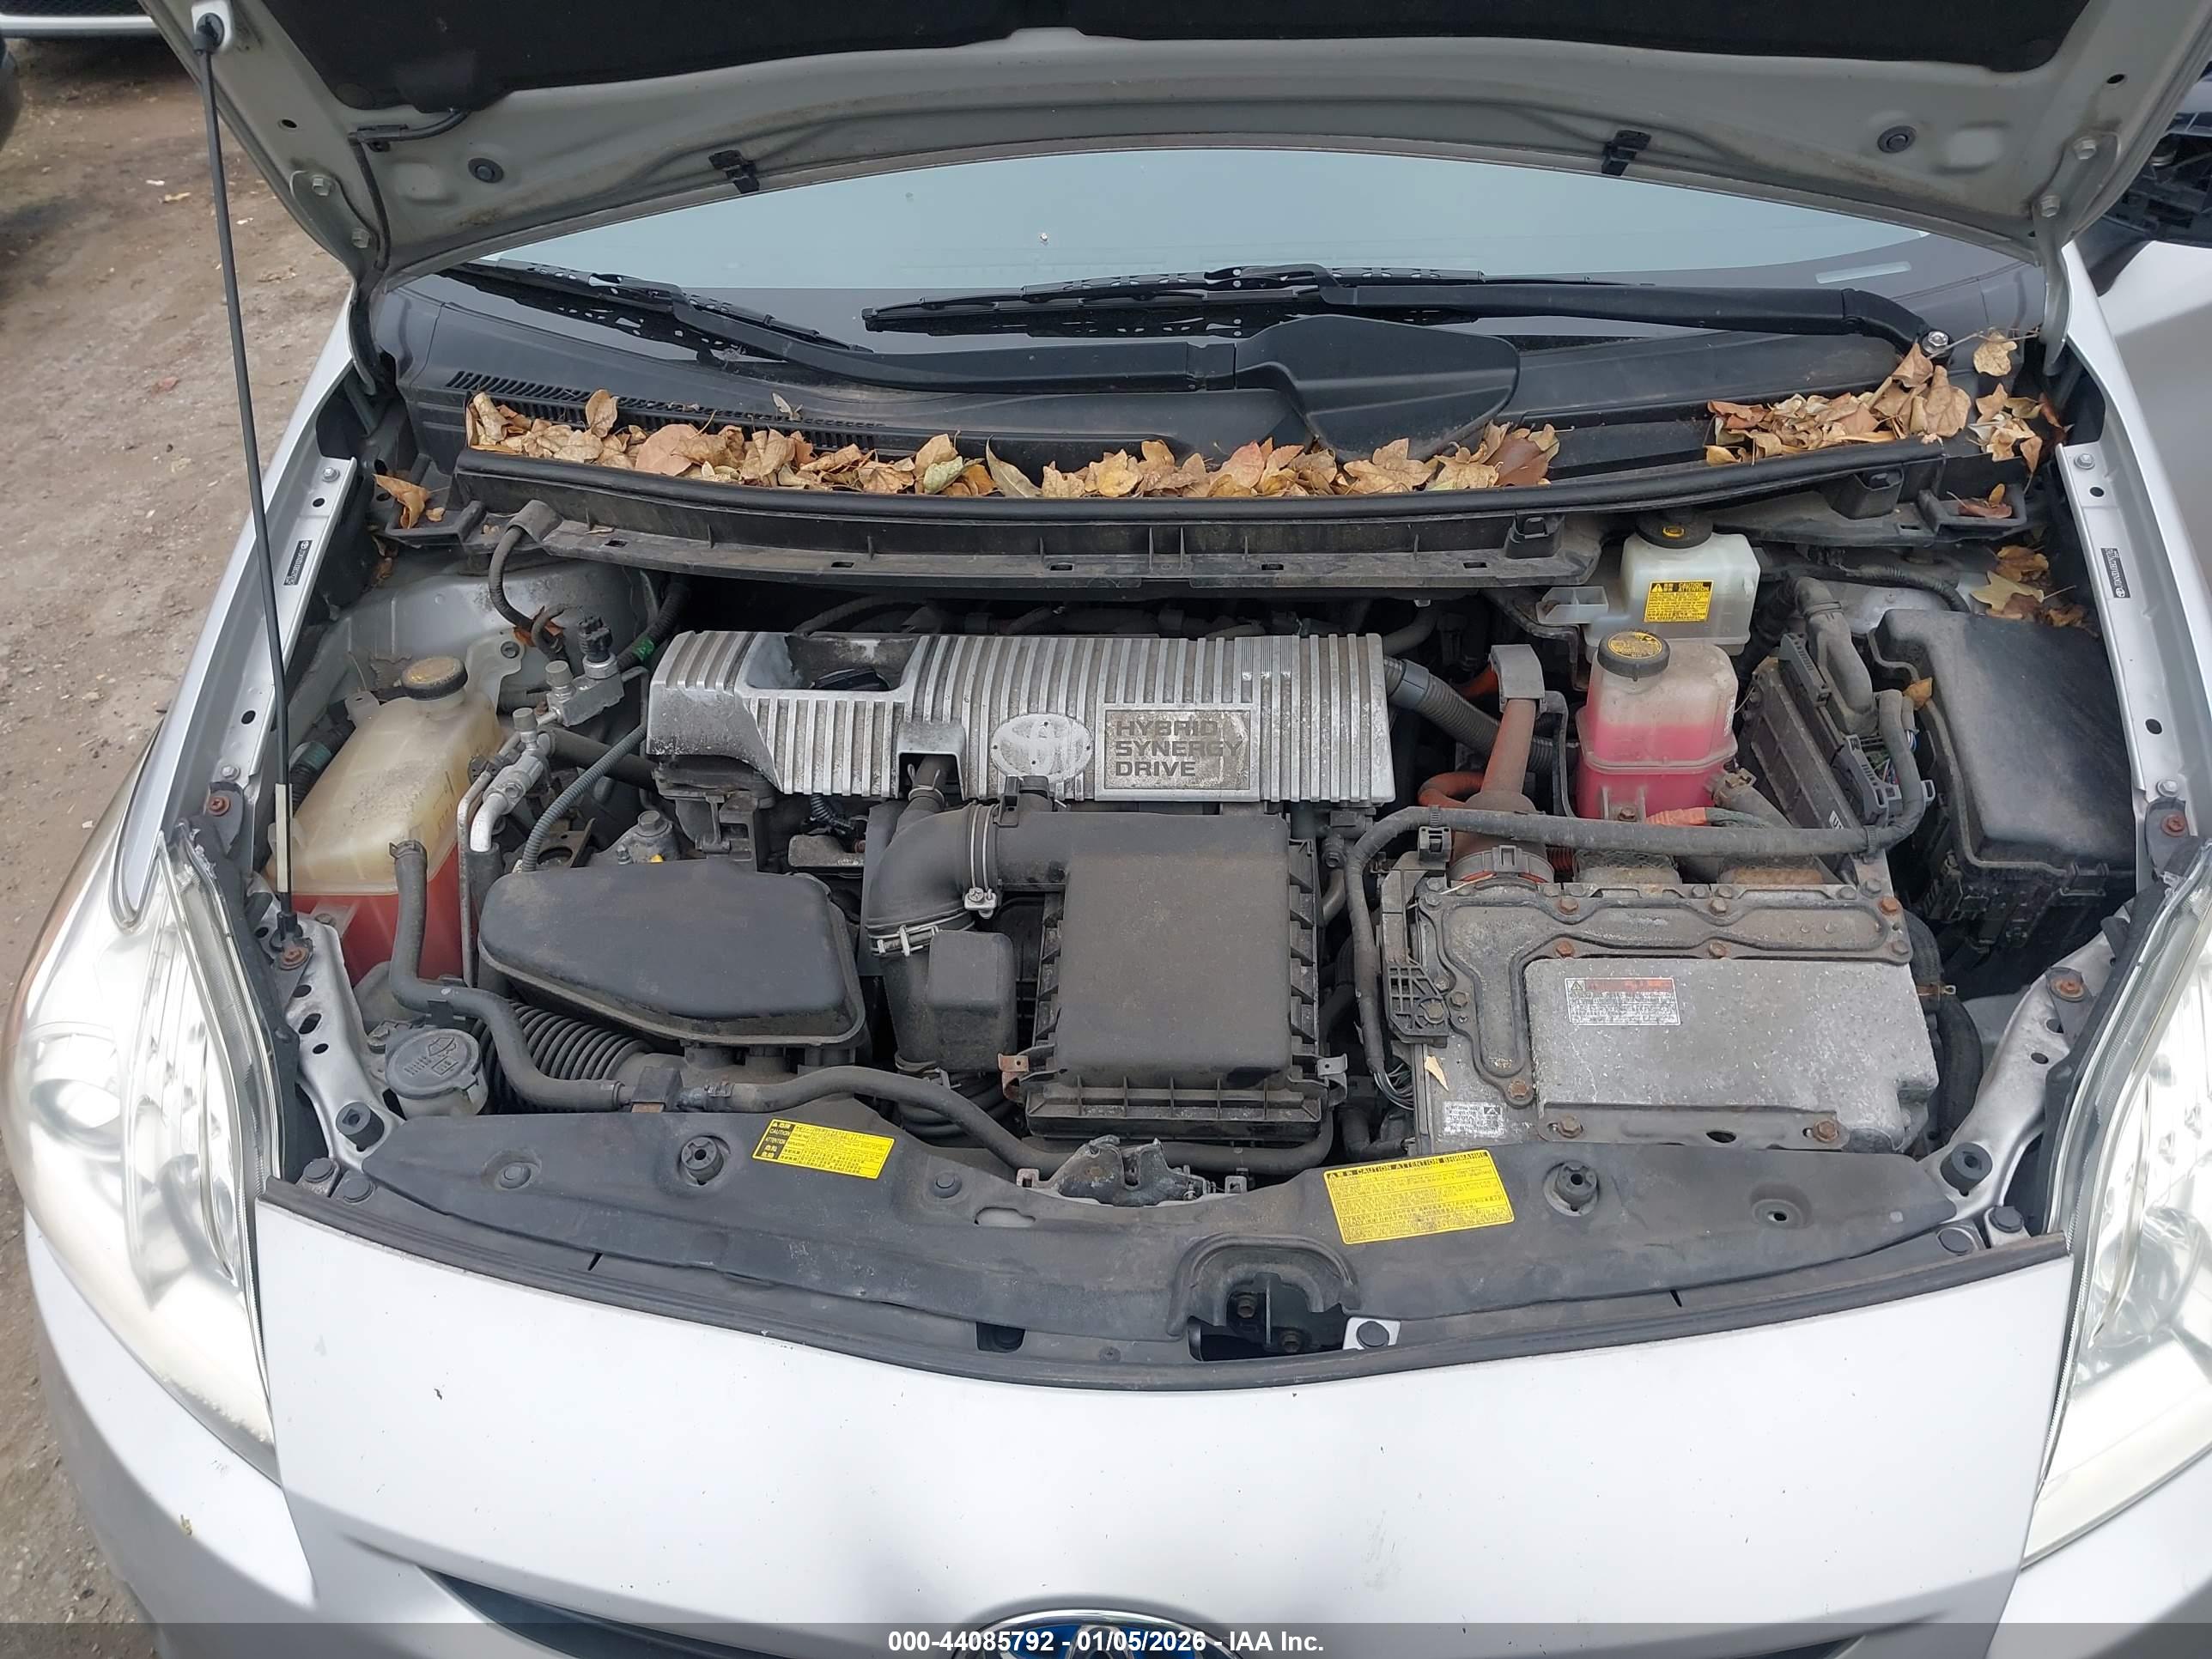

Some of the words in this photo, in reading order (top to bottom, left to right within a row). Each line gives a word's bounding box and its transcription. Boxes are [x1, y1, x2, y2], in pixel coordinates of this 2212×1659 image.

[1116, 720, 1218, 736] HYBRID
[1115, 740, 1243, 757] SYNERGY
[1115, 761, 1196, 777] DRIVE
[1356, 1164, 1390, 1176] CAUTION
[1395, 1158, 1438, 1170] ATTENTION
